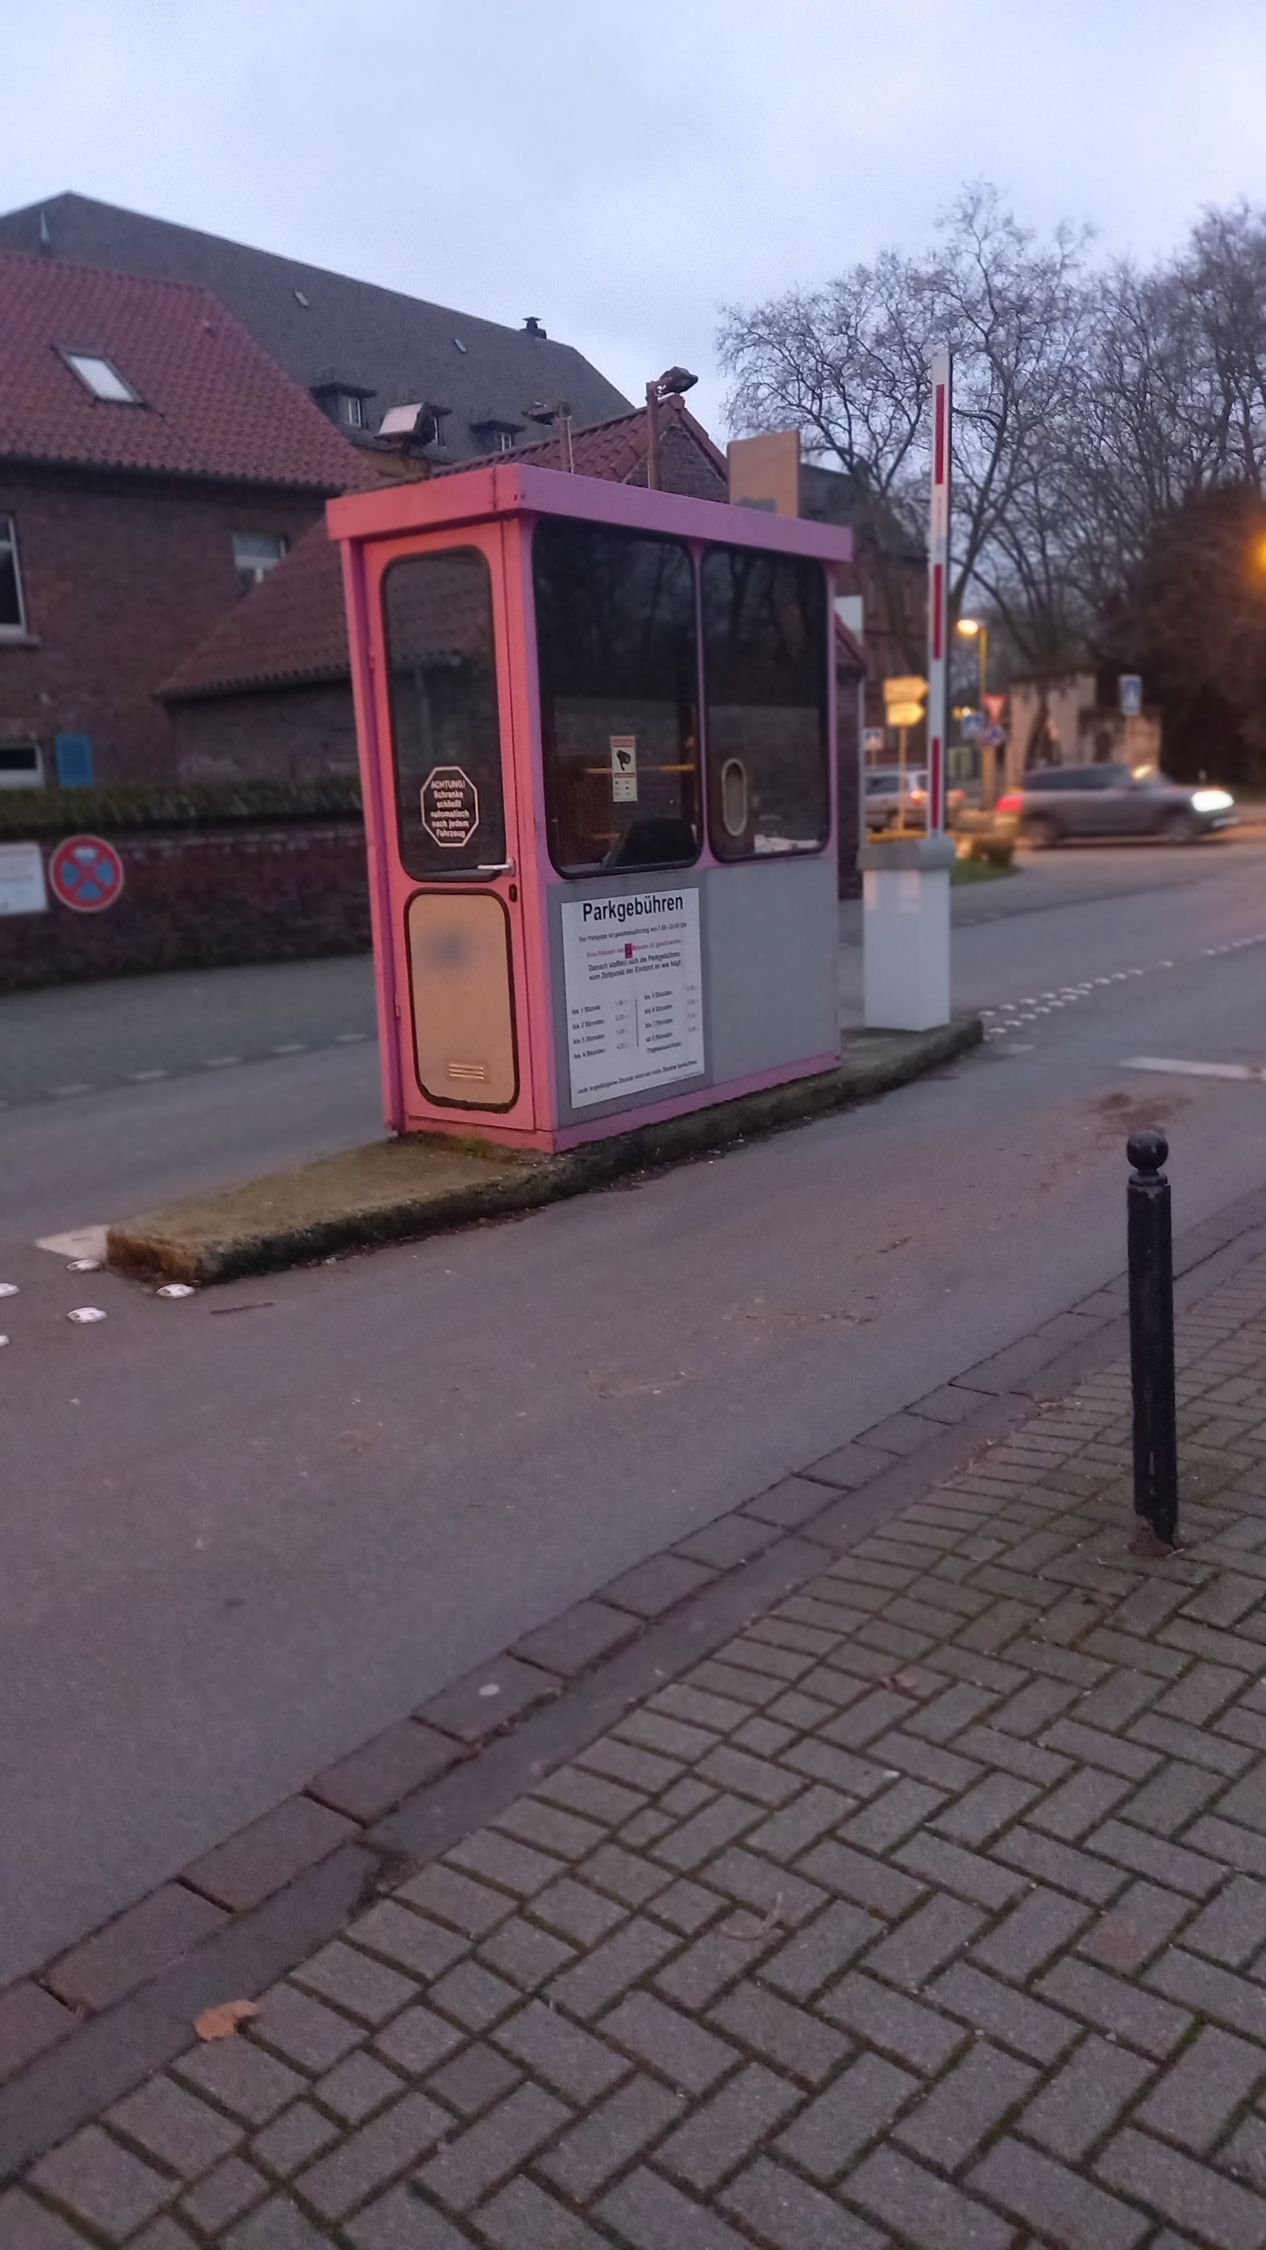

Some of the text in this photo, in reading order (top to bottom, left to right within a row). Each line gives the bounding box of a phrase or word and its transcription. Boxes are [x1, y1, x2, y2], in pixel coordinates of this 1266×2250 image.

[431, 780, 465, 789] ACHTUNG!
[433, 790, 463, 799] Schranke
[436, 829, 465, 838] Fahrzeug
[583, 895, 683, 922] Parkgebühren
